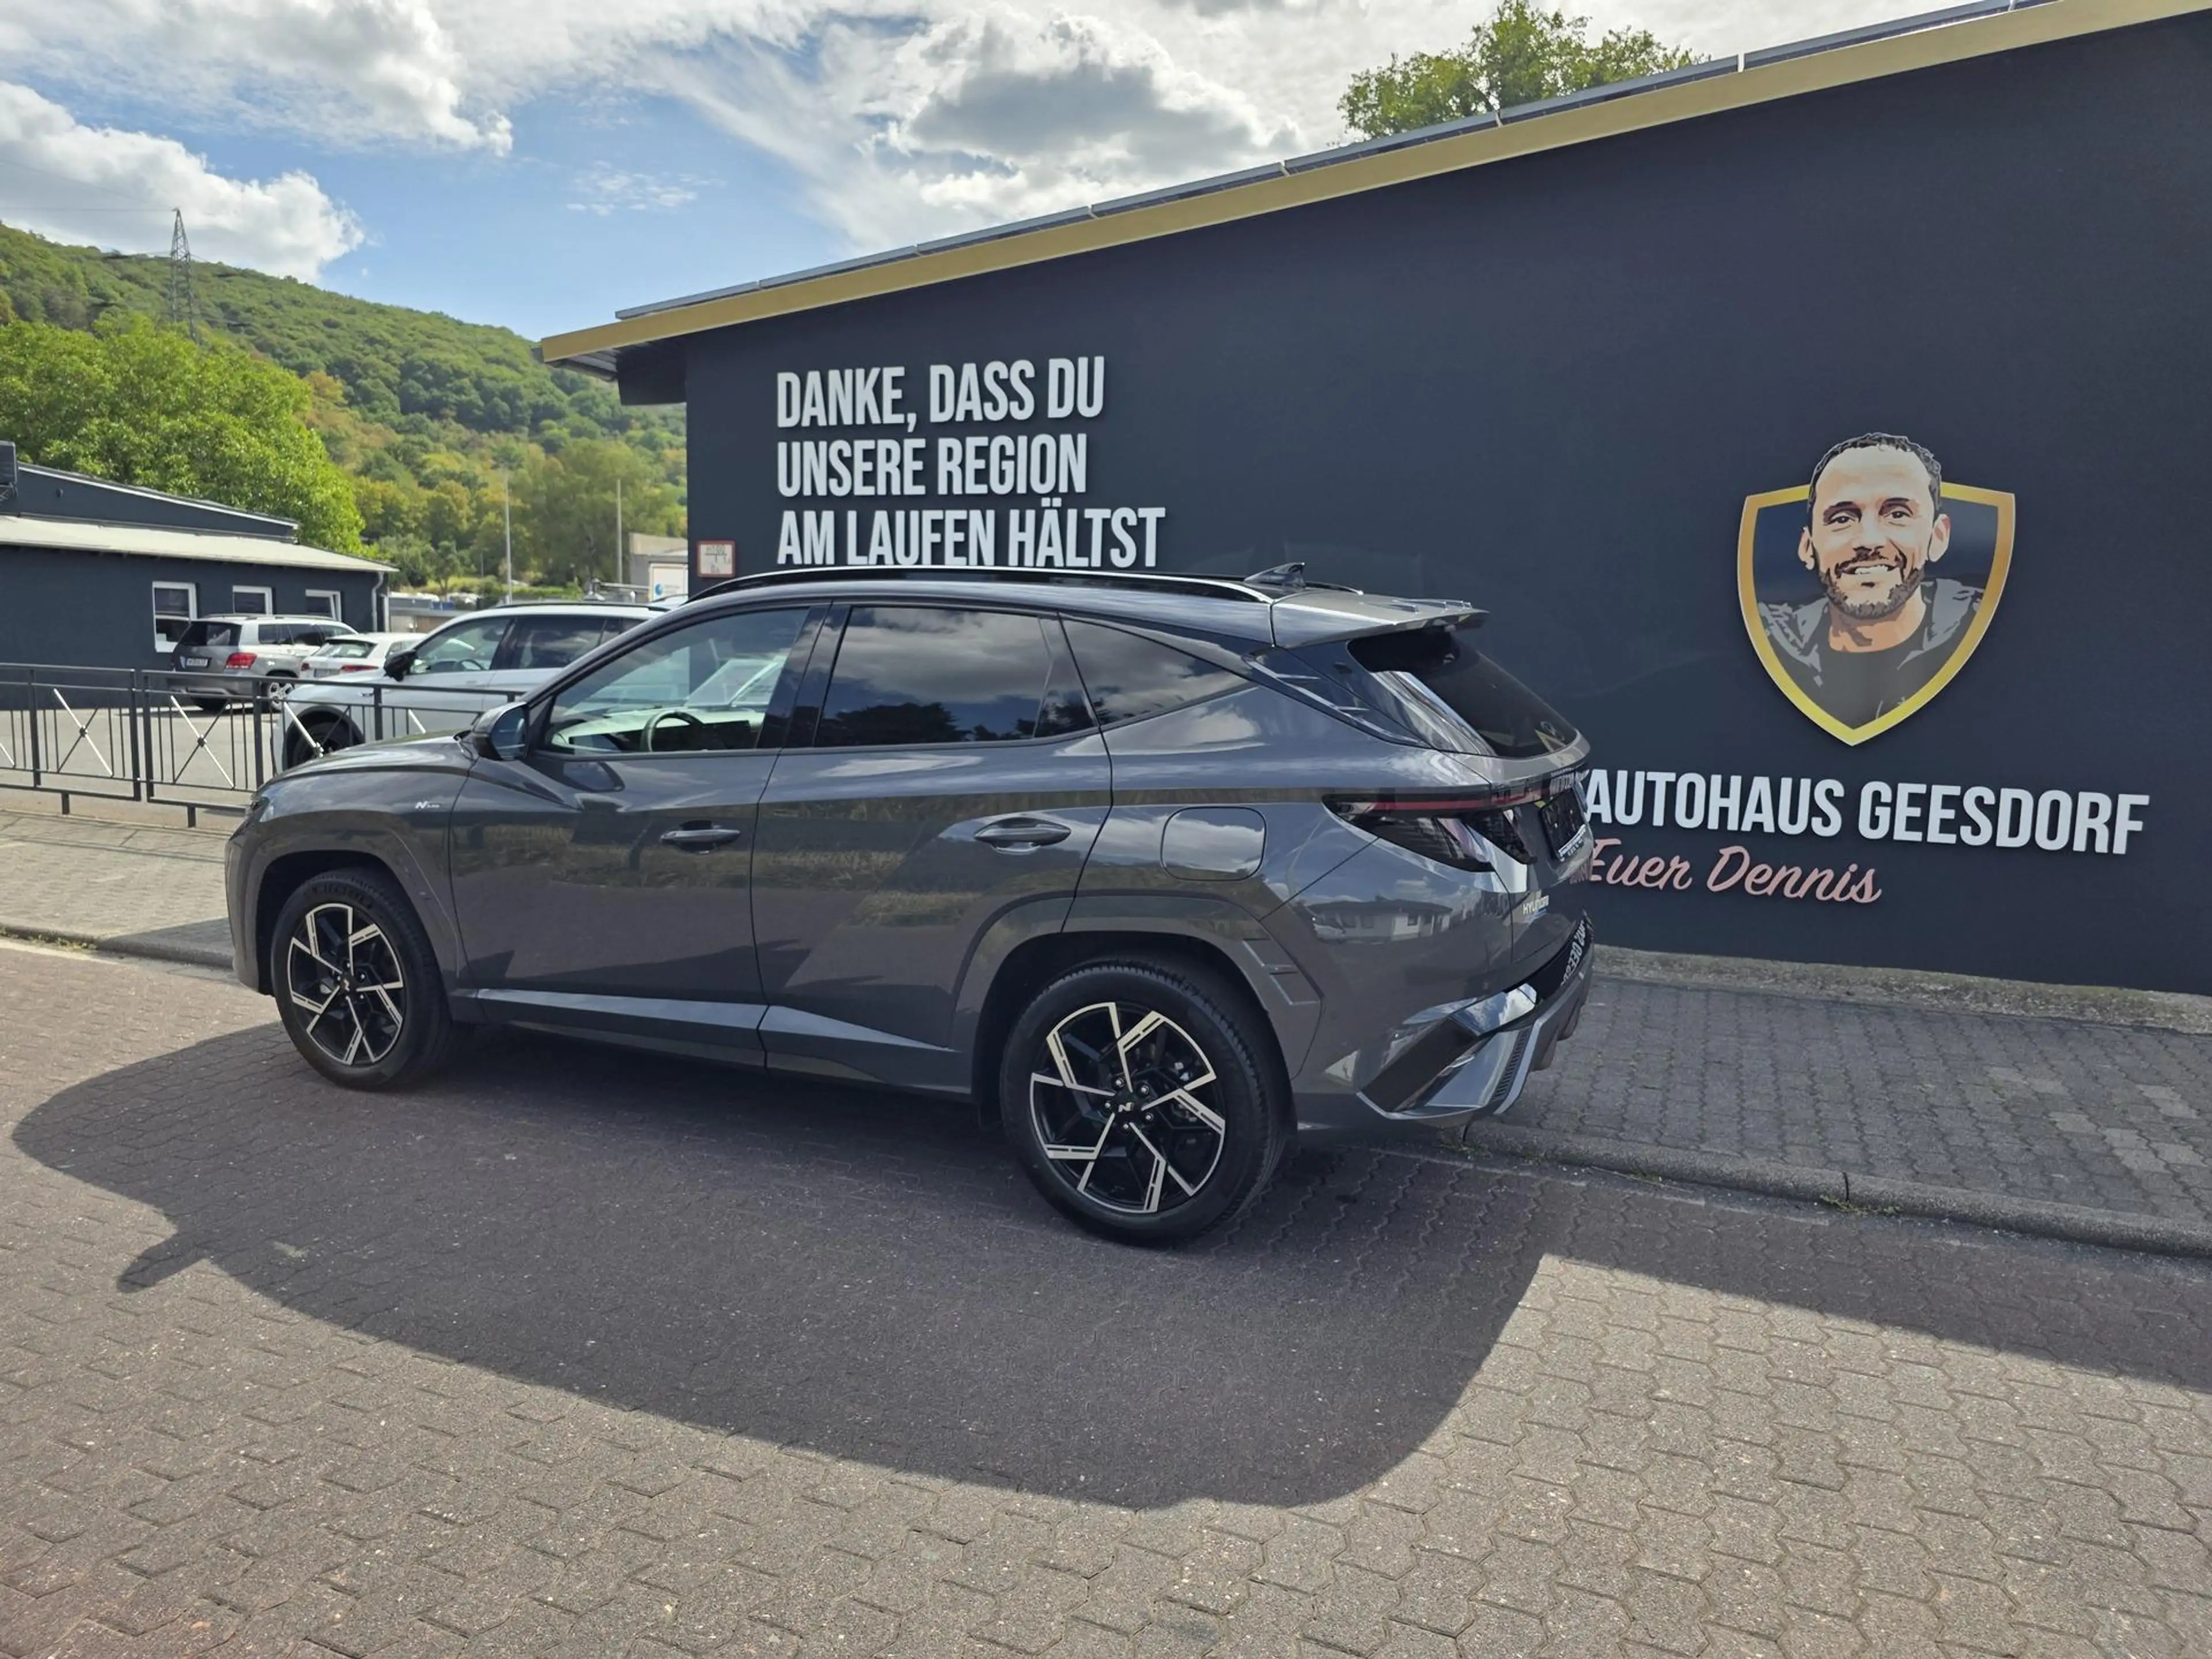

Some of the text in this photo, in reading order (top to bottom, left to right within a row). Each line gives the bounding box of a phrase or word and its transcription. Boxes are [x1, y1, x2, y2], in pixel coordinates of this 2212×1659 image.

[777, 356, 1104, 433] DANKE, DASS DU
[778, 433, 1087, 497] UNSERE REGION
[777, 497, 1166, 567] AM LAUFEN HÄLTST
[1584, 769, 2150, 854] AUTOHAUS GEESDORF
[1590, 838, 1692, 890] Euer
[1706, 846, 1882, 903] Dennis
